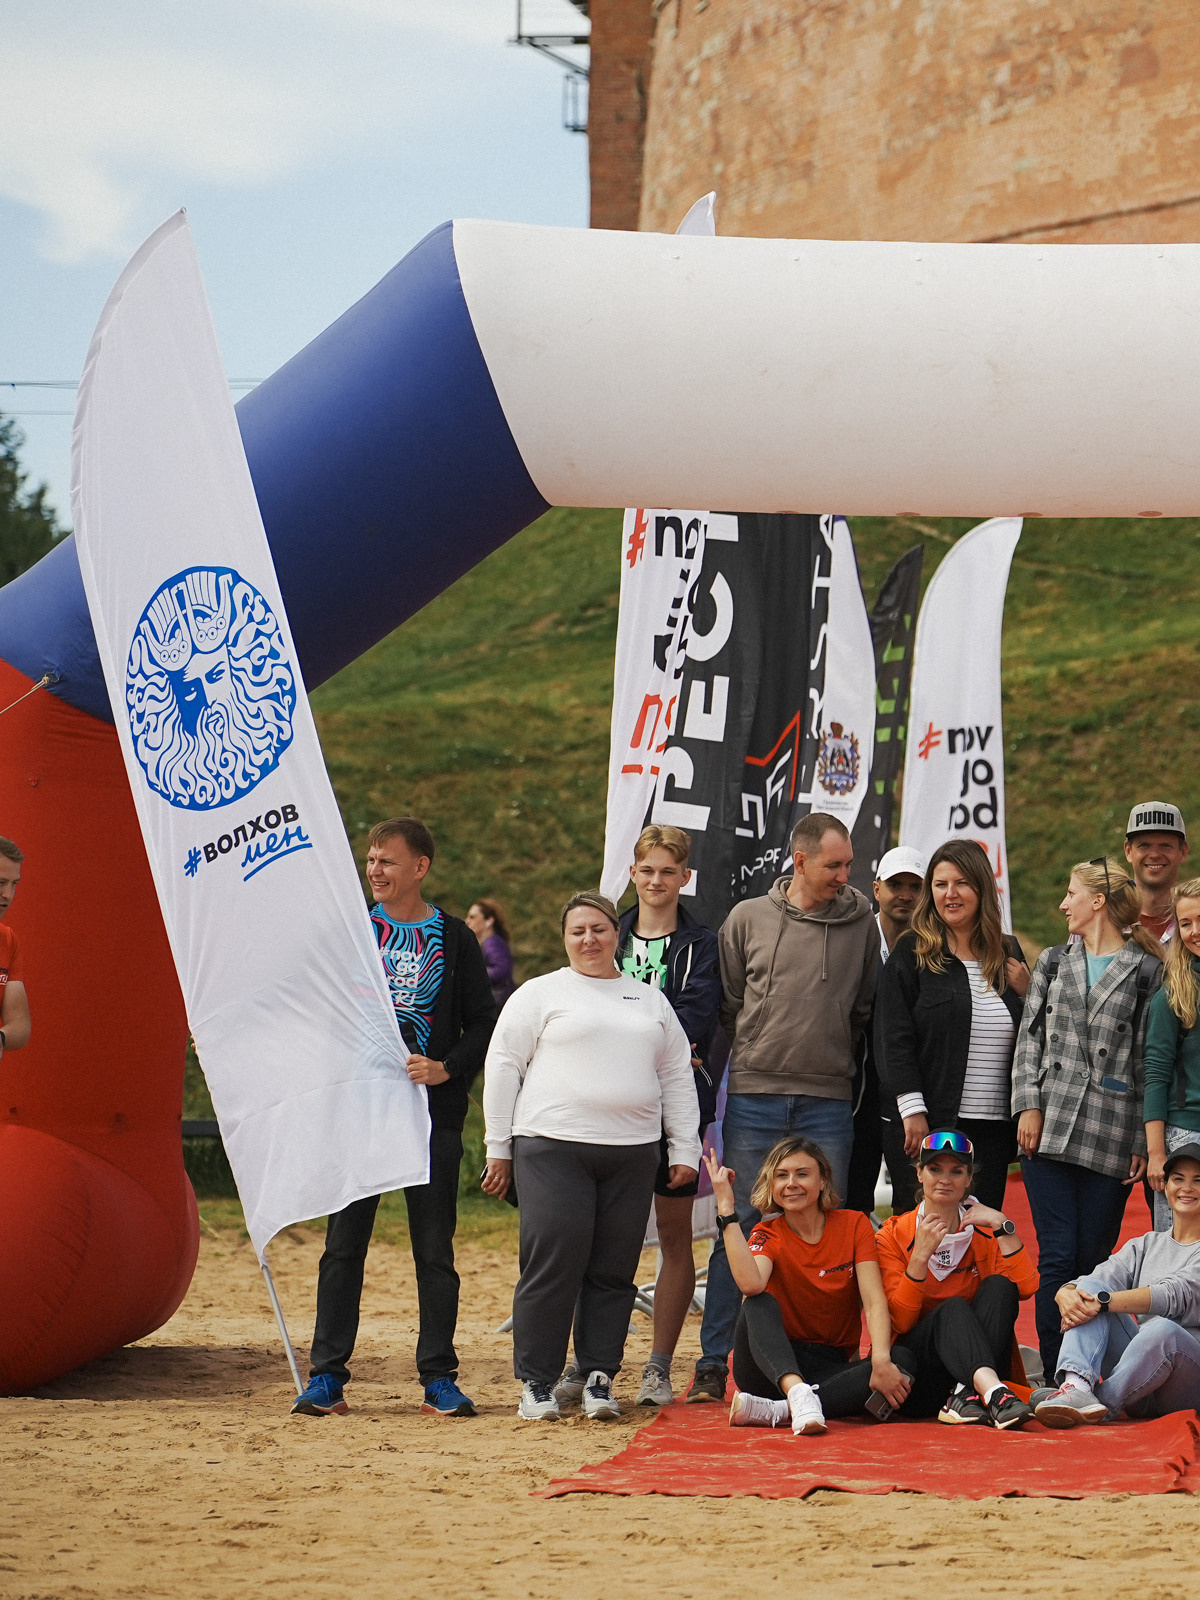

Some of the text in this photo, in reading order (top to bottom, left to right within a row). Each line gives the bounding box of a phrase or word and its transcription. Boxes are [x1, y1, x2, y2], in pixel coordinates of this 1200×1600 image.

[1136, 811, 1175, 828] PUMA
[184, 803, 300, 878] #ВОЛХОВ
[396, 960, 420, 976] go
